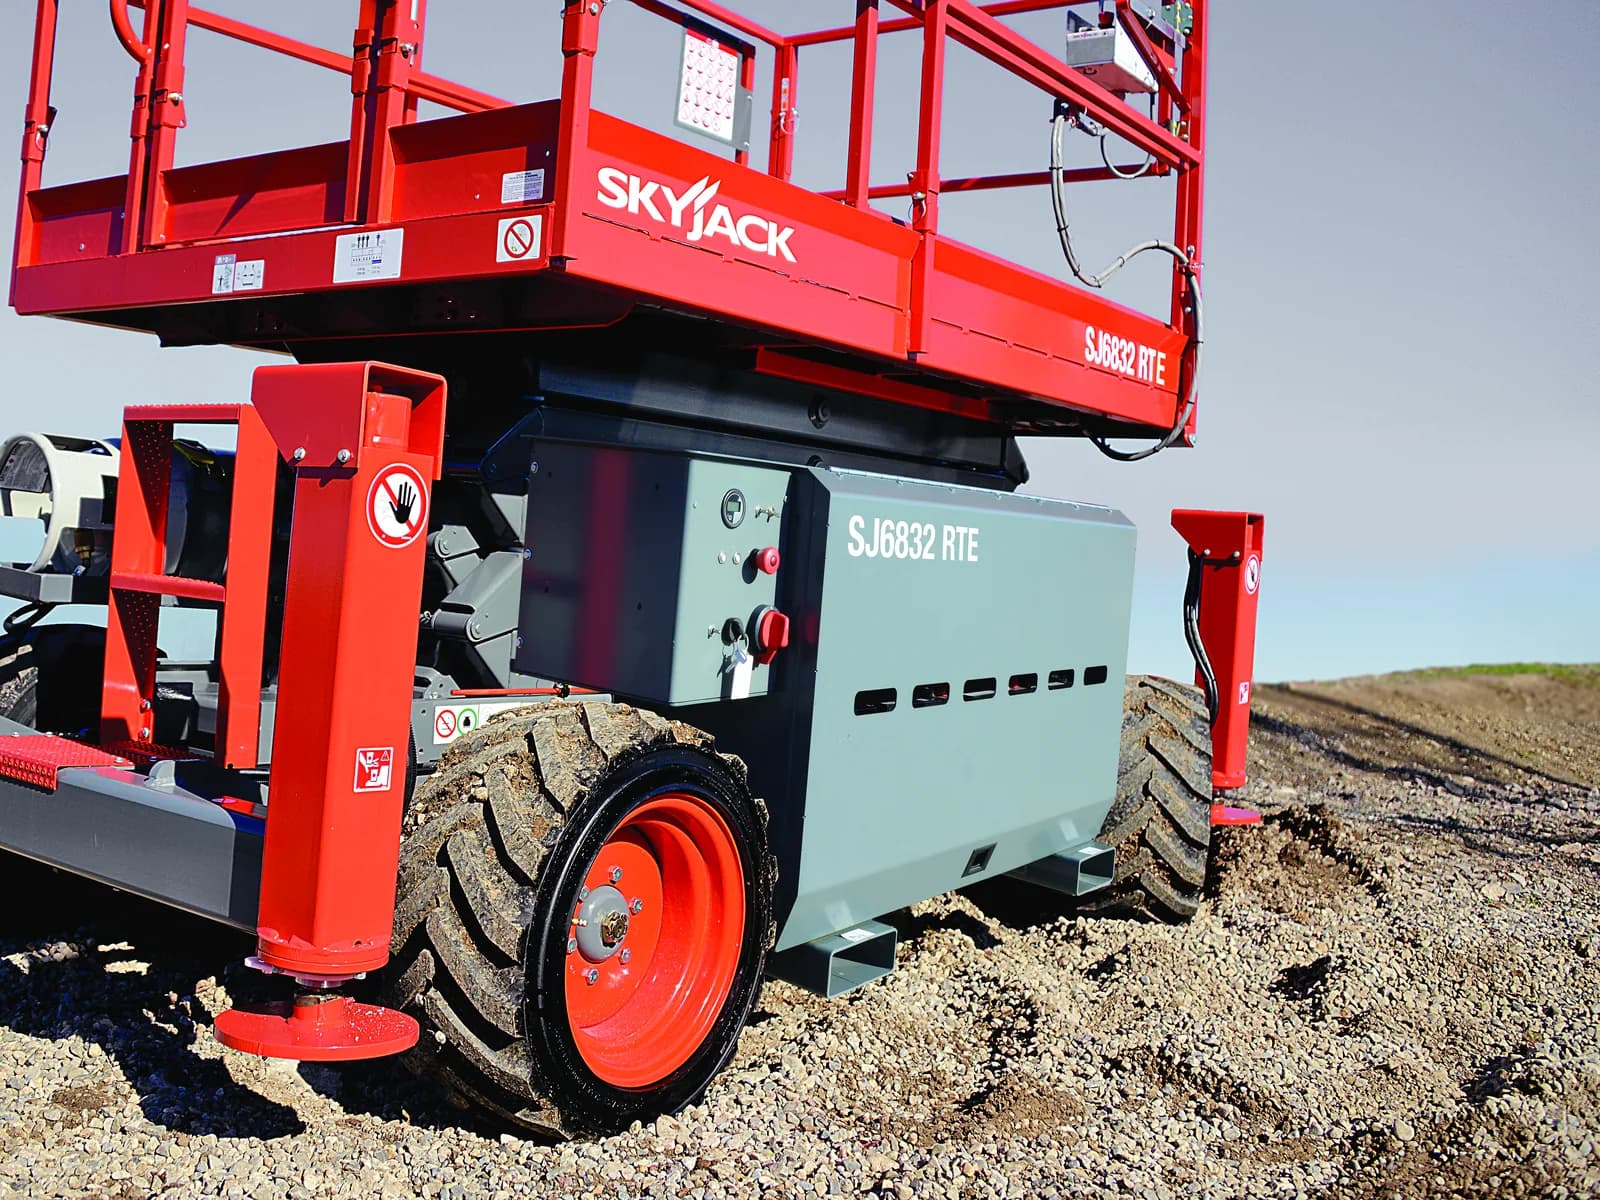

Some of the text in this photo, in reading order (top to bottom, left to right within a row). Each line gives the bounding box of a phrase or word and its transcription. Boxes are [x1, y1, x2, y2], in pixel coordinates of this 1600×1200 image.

[597, 167, 797, 263] SKYJACK
[1084, 325, 1167, 386] SJ6832 RTE
[847, 514, 979, 562] SJ6832 RTE
